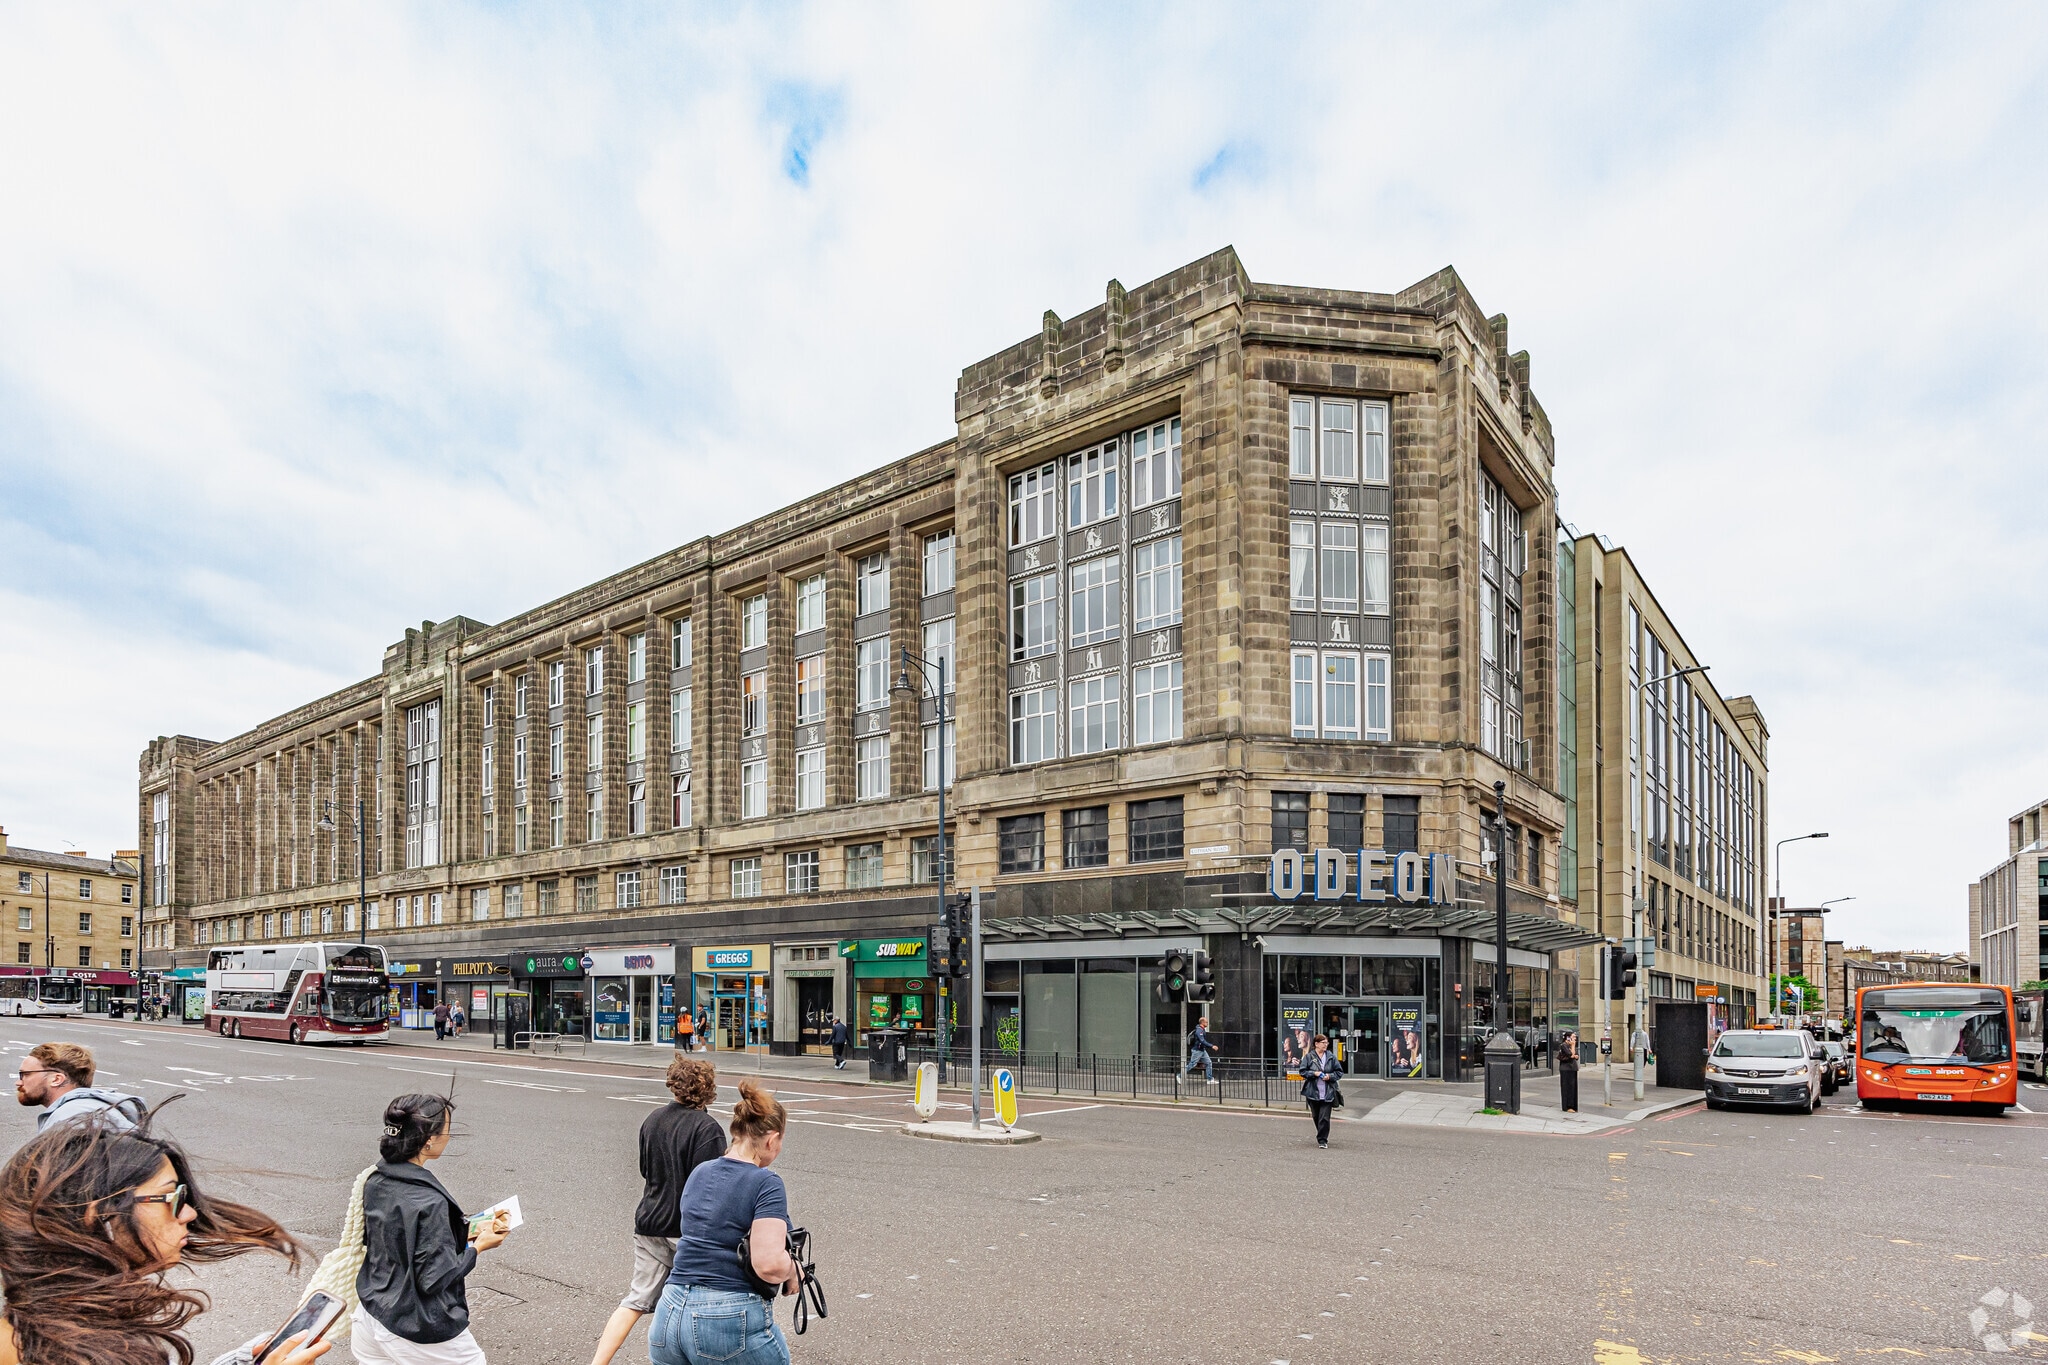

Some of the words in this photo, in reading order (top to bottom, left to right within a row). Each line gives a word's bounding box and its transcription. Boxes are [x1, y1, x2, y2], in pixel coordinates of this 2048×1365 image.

[1271, 848, 1456, 906] ODEON
[876, 941, 922, 957] SUBWAY
[536, 957, 557, 967] aura
[624, 955, 654, 969] BENTO
[715, 952, 749, 965] GREGGS
[453, 962, 493, 975] PHILPOT'S
[368, 976, 379, 984] 16
